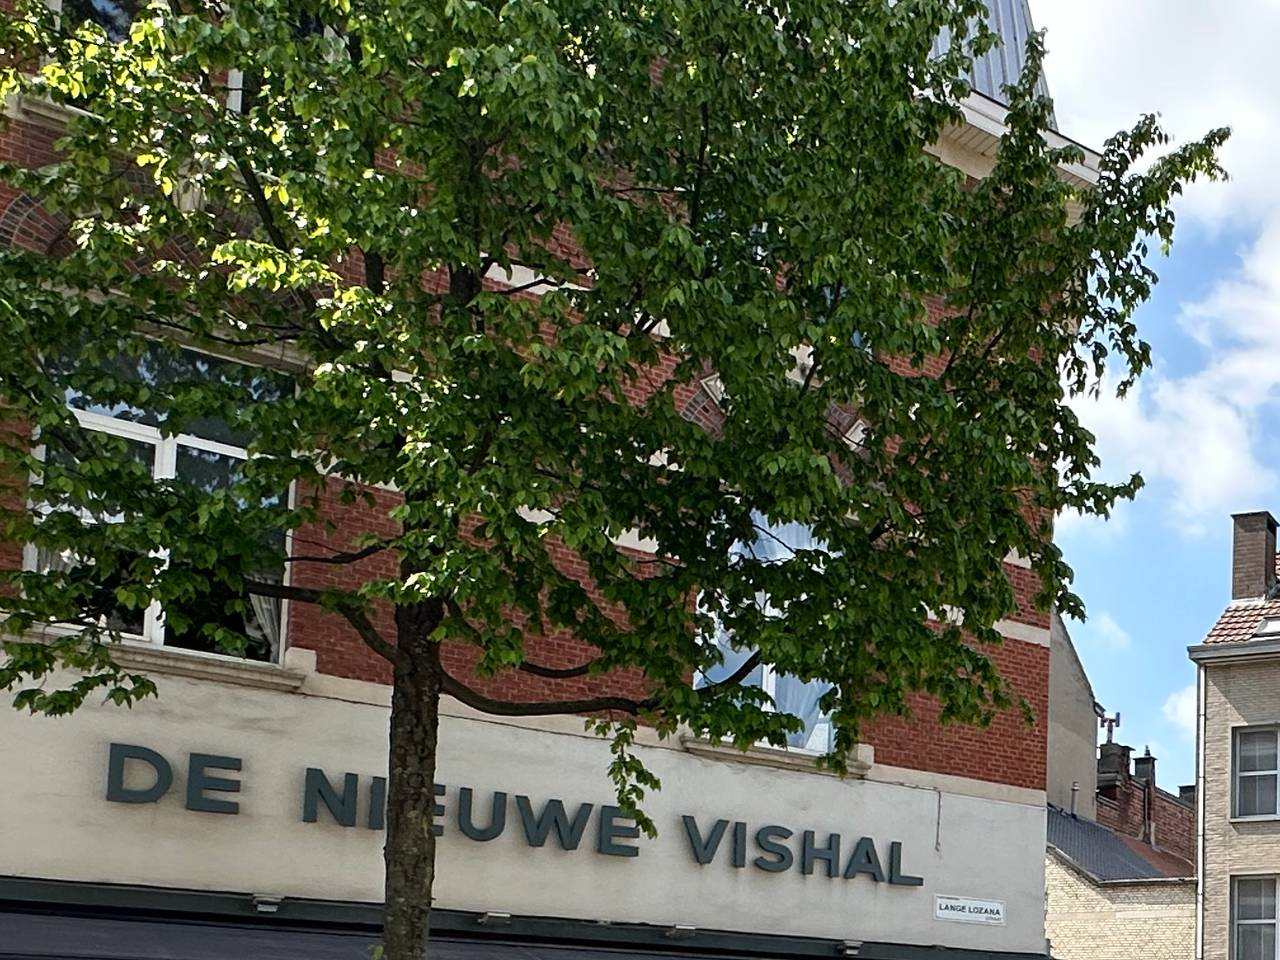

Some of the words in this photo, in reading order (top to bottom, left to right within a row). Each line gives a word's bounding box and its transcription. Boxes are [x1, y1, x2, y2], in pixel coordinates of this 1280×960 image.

[106, 743, 242, 815] DE
[302, 767, 640, 858] NIUWE
[682, 814, 924, 887] VISHAL
[939, 902, 967, 913] LANGE
[967, 906, 1001, 916] LOZANA
